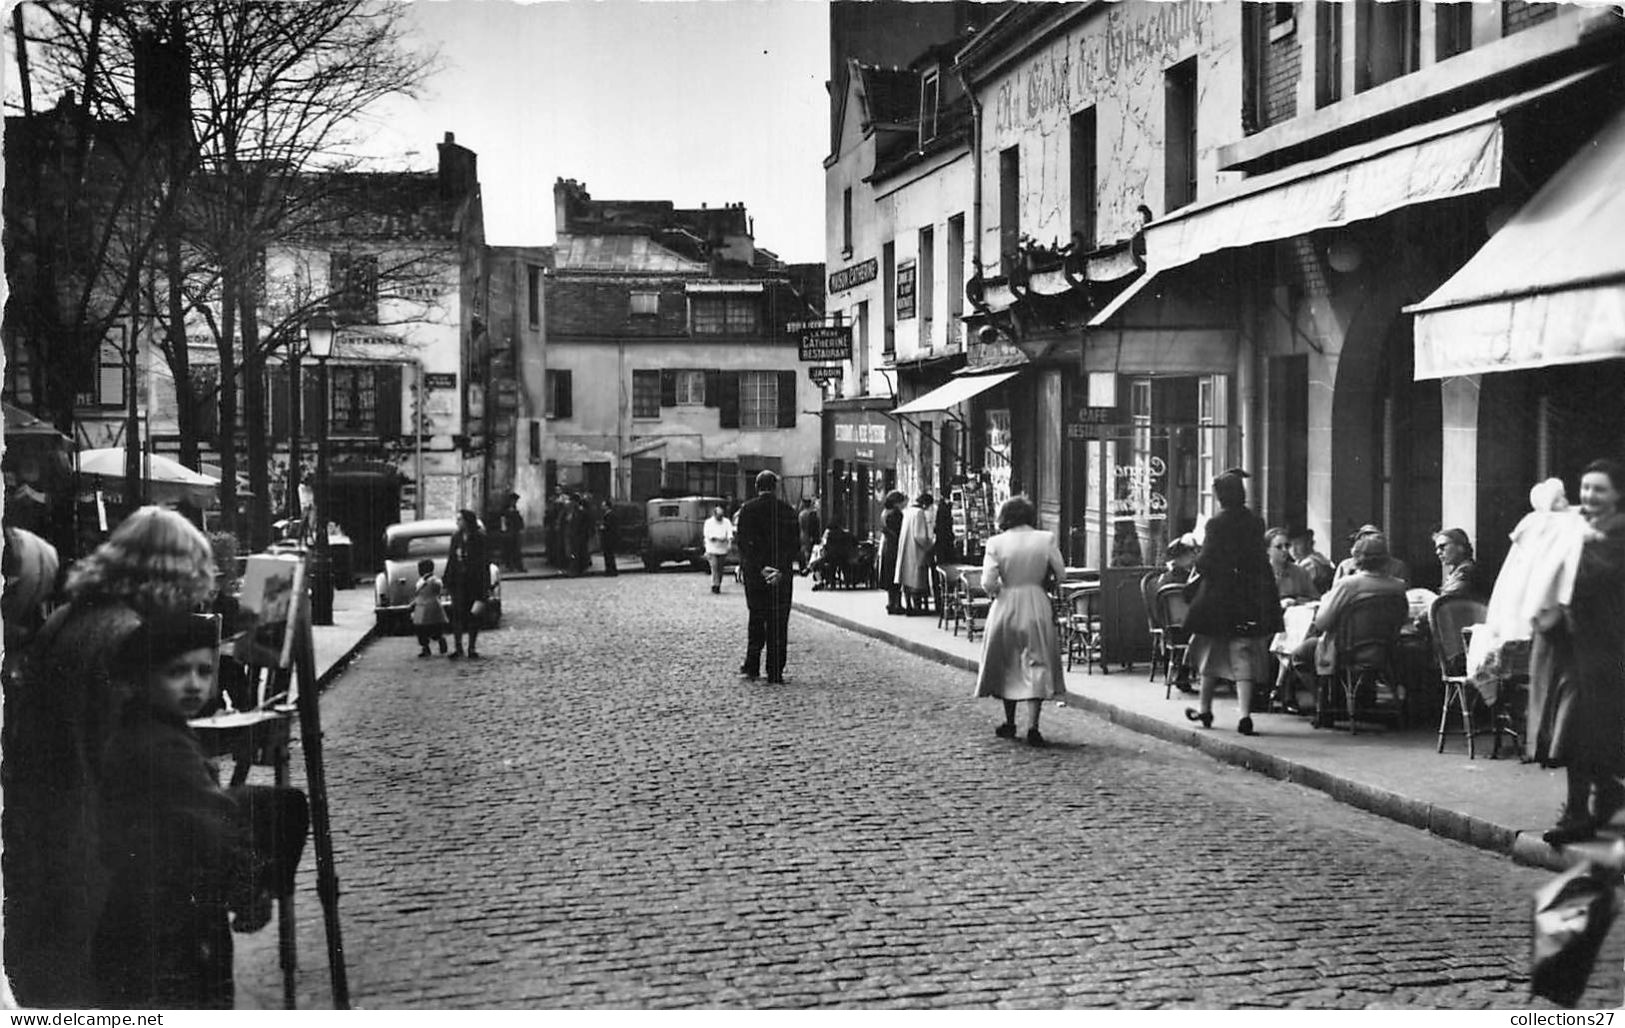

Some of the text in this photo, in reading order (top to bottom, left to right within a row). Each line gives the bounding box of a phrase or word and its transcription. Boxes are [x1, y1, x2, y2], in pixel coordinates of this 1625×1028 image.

[849, 260, 875, 285] CATHERINE
[803, 335, 848, 348] CATHERINE
[803, 348, 849, 359] RESTAURANT
